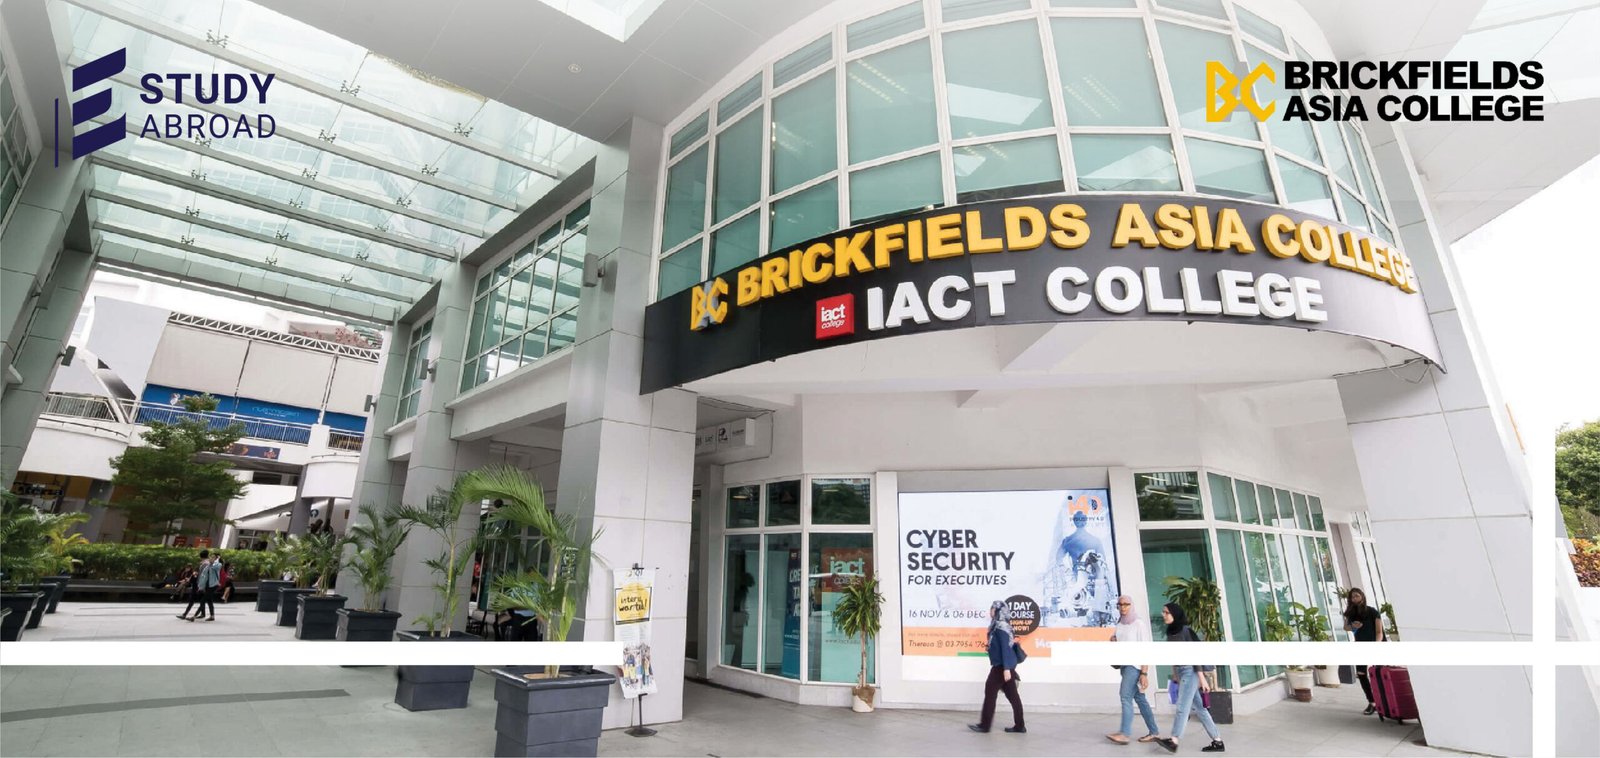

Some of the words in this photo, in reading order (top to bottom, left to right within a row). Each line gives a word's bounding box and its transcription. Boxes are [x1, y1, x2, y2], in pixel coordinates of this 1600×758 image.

[737, 204, 1091, 307] BRICKFIELDS
[1112, 203, 1256, 253] ASIA
[1261, 214, 1418, 294] COLLEGE
[867, 269, 1017, 331] IACT
[1045, 265, 1329, 323] COLLEGE
[821, 304, 846, 322] iact
[906, 529, 979, 549] CYBER
[830, 556, 865, 577] iact
[907, 551, 1016, 571] SECURITY
[907, 575, 932, 586] FOR
[935, 575, 1007, 586] EXECUTIVES
[909, 610, 918, 618] 16
[920, 609, 942, 618] NOV
[944, 609, 951, 618] &
[953, 609, 965, 618] 06
[967, 609, 986, 618] DEC
[1008, 611, 1035, 619] OURSE
[1009, 602, 1012, 610] 1
[1013, 602, 1032, 610] DAY
